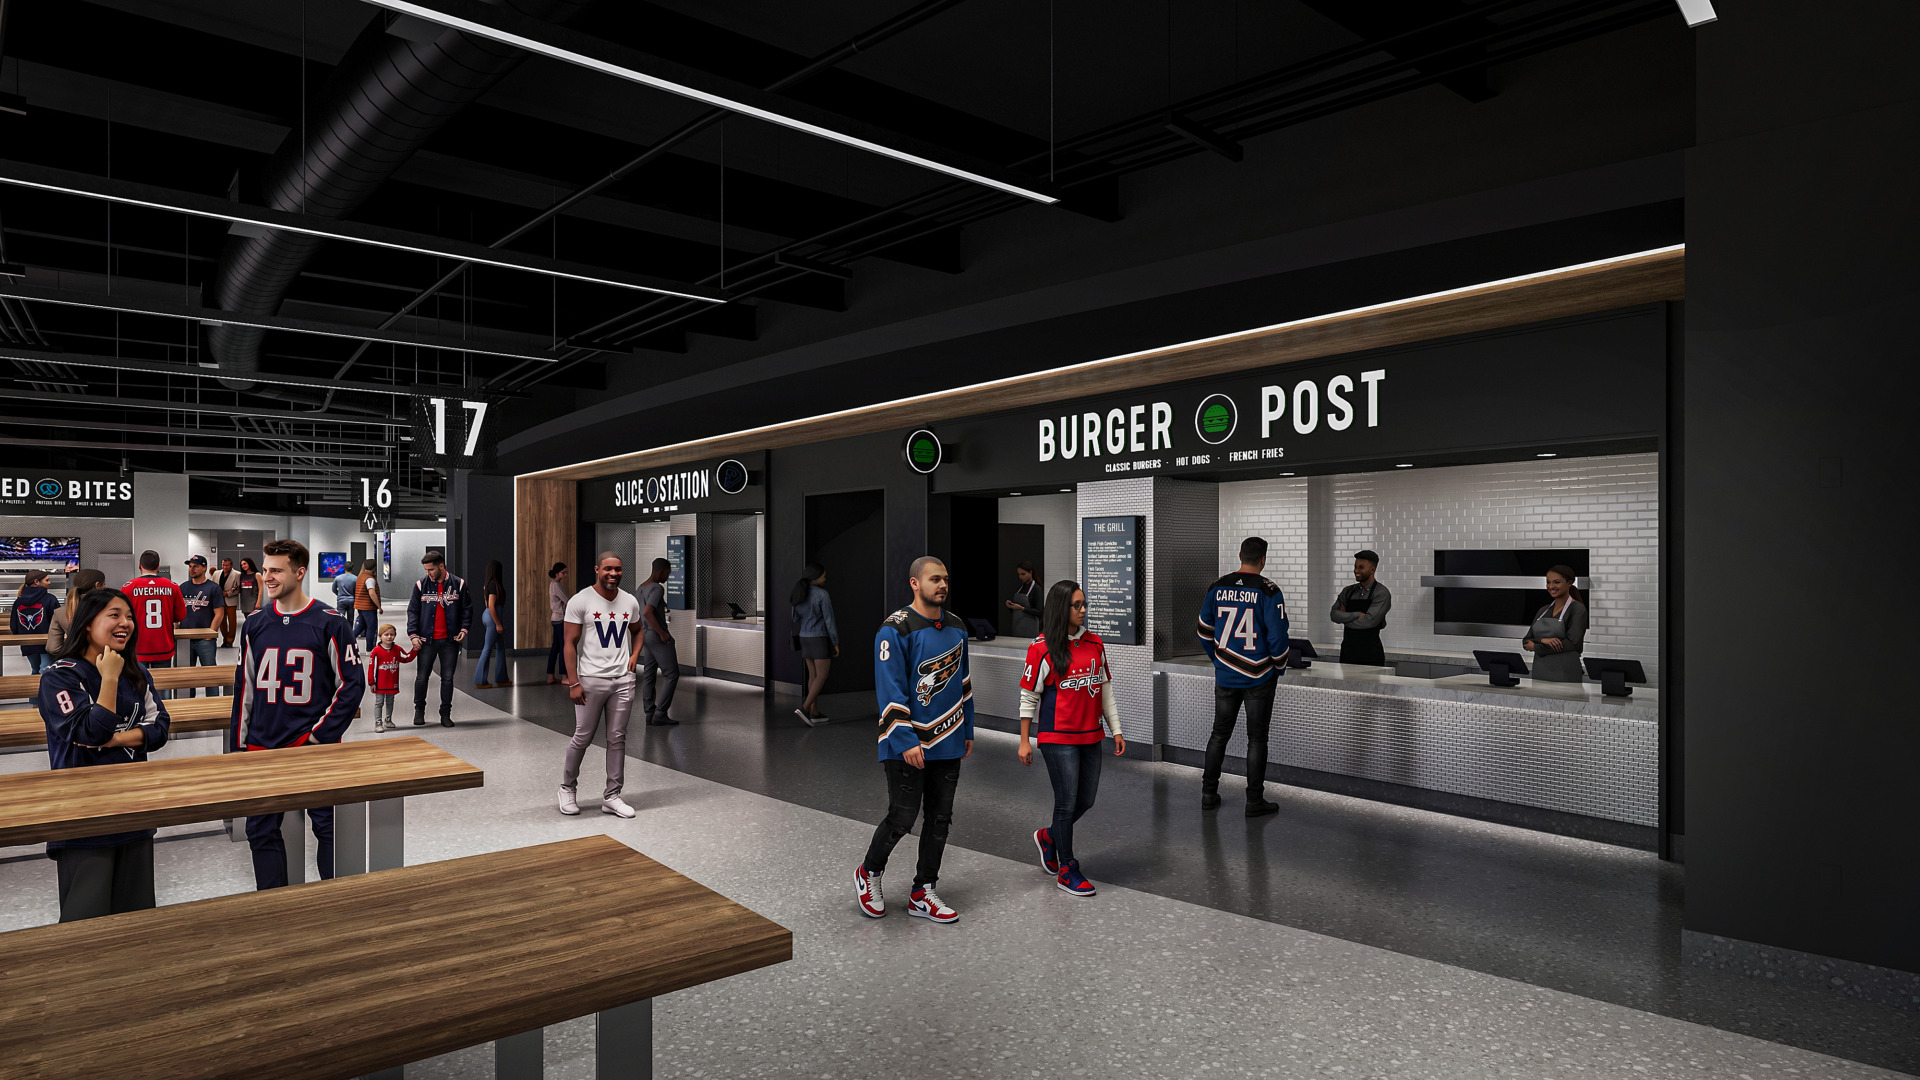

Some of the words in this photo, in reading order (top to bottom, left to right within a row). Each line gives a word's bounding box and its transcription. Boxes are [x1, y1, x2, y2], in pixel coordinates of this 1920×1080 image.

[430, 398, 488, 456] 17
[1039, 402, 1172, 462] BURGER
[1261, 369, 1386, 439] POST
[1105, 462, 1131, 473] CLASSIC
[1133, 459, 1162, 471] BURGERS
[1176, 456, 1189, 467] HOT
[1192, 454, 1211, 465] DOGS
[1229, 450, 1258, 462] FRENCH
[1261, 447, 1284, 459] FRIES
[2, 478, 30, 498] ED
[68, 480, 132, 501] BITES
[360, 477, 392, 508] 16
[615, 479, 644, 506] SLICE
[659, 469, 710, 502] STATION
[1094, 523, 1106, 533] THE
[1107, 522, 1126, 532] GRILL
[132, 586, 173, 597] OVECHKIN
[1216, 589, 1258, 604] CARLSON
[145, 599, 163, 629] 8
[594, 621, 629, 649] W
[1217, 606, 1258, 651] 74
[879, 640, 891, 662] 8
[256, 647, 315, 706] 43
[56, 690, 75, 715] 8
